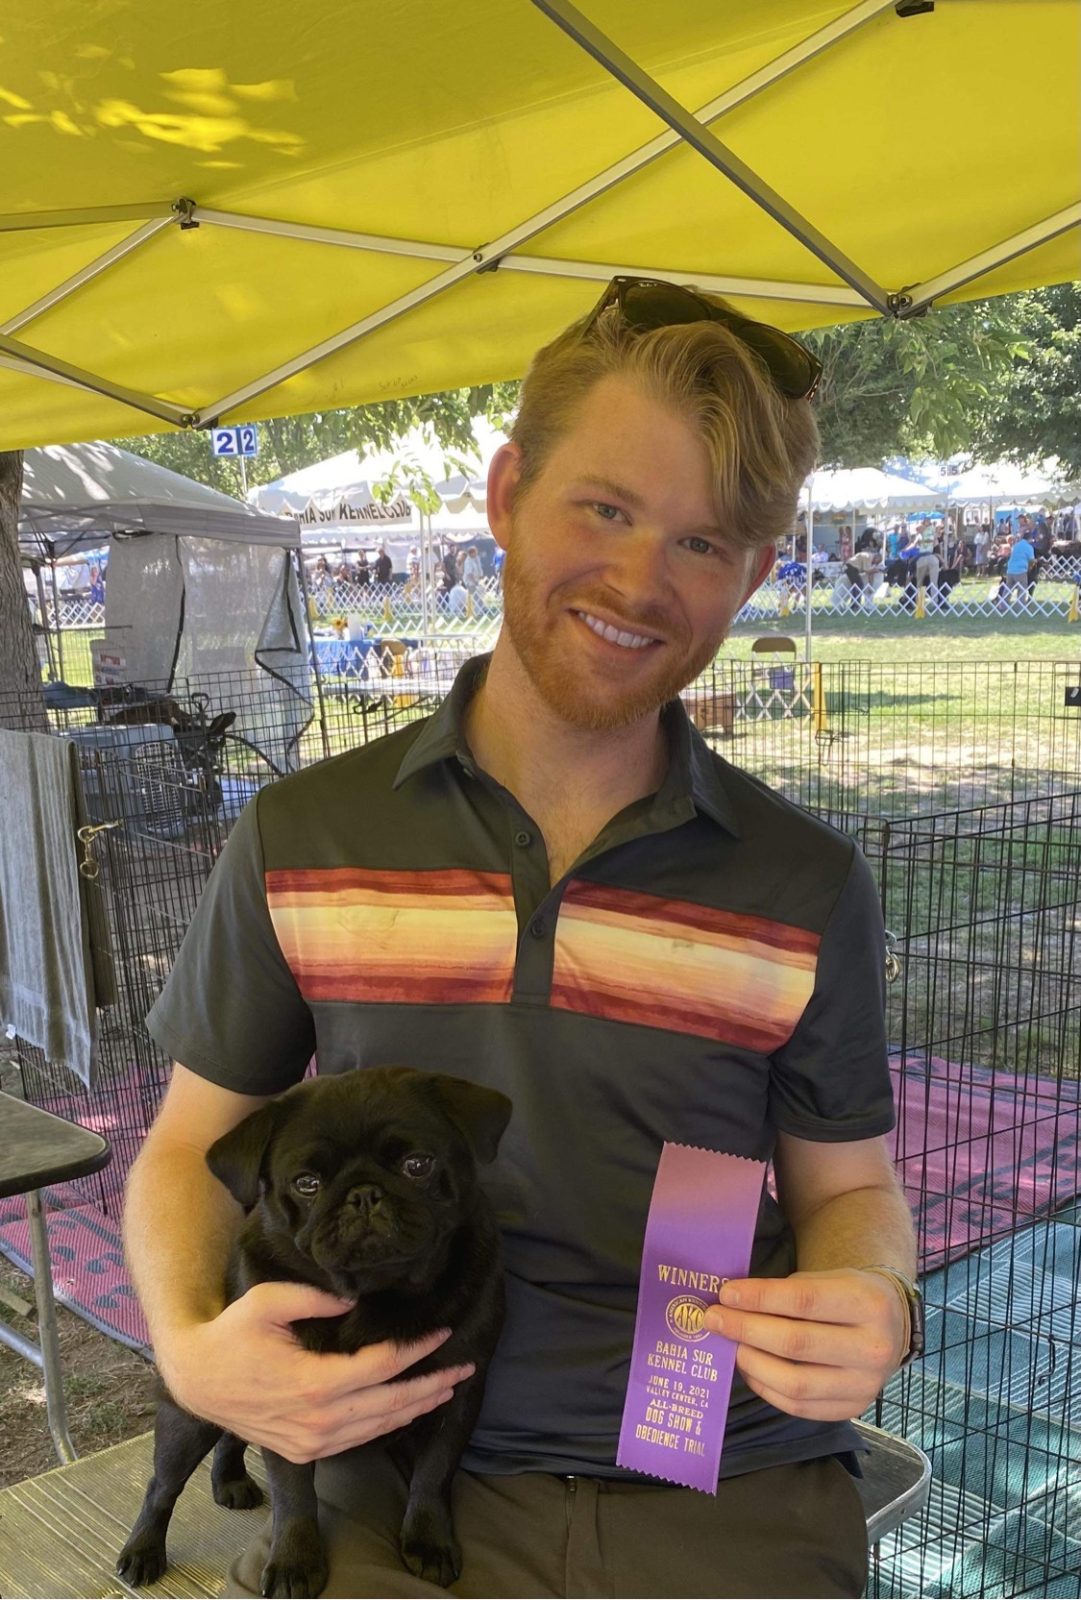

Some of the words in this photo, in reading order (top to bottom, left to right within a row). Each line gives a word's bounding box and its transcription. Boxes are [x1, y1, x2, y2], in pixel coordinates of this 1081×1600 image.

[217, 432, 234, 453] 2
[244, 429, 254, 451] 2
[339, 503, 386, 520] KENNEL
[384, 500, 412, 519] CLUB
[656, 1341, 688, 1359] BAHIA
[692, 1349, 713, 1366] SUR
[647, 1353, 687, 1375] KENNEL
[691, 1364, 718, 1382] CLUB
[646, 1385, 670, 1398] VALLEY
[648, 1375, 670, 1389] JUNE
[689, 1385, 710, 1399] 2021
[649, 1398, 704, 1419] ALL-BREED
[645, 1407, 665, 1425] DOG
[667, 1412, 693, 1433] SHOW
[695, 1421, 702, 1435] &
[635, 1424, 680, 1450] OBEDIENCE
[684, 1437, 705, 1455] TRIAL
